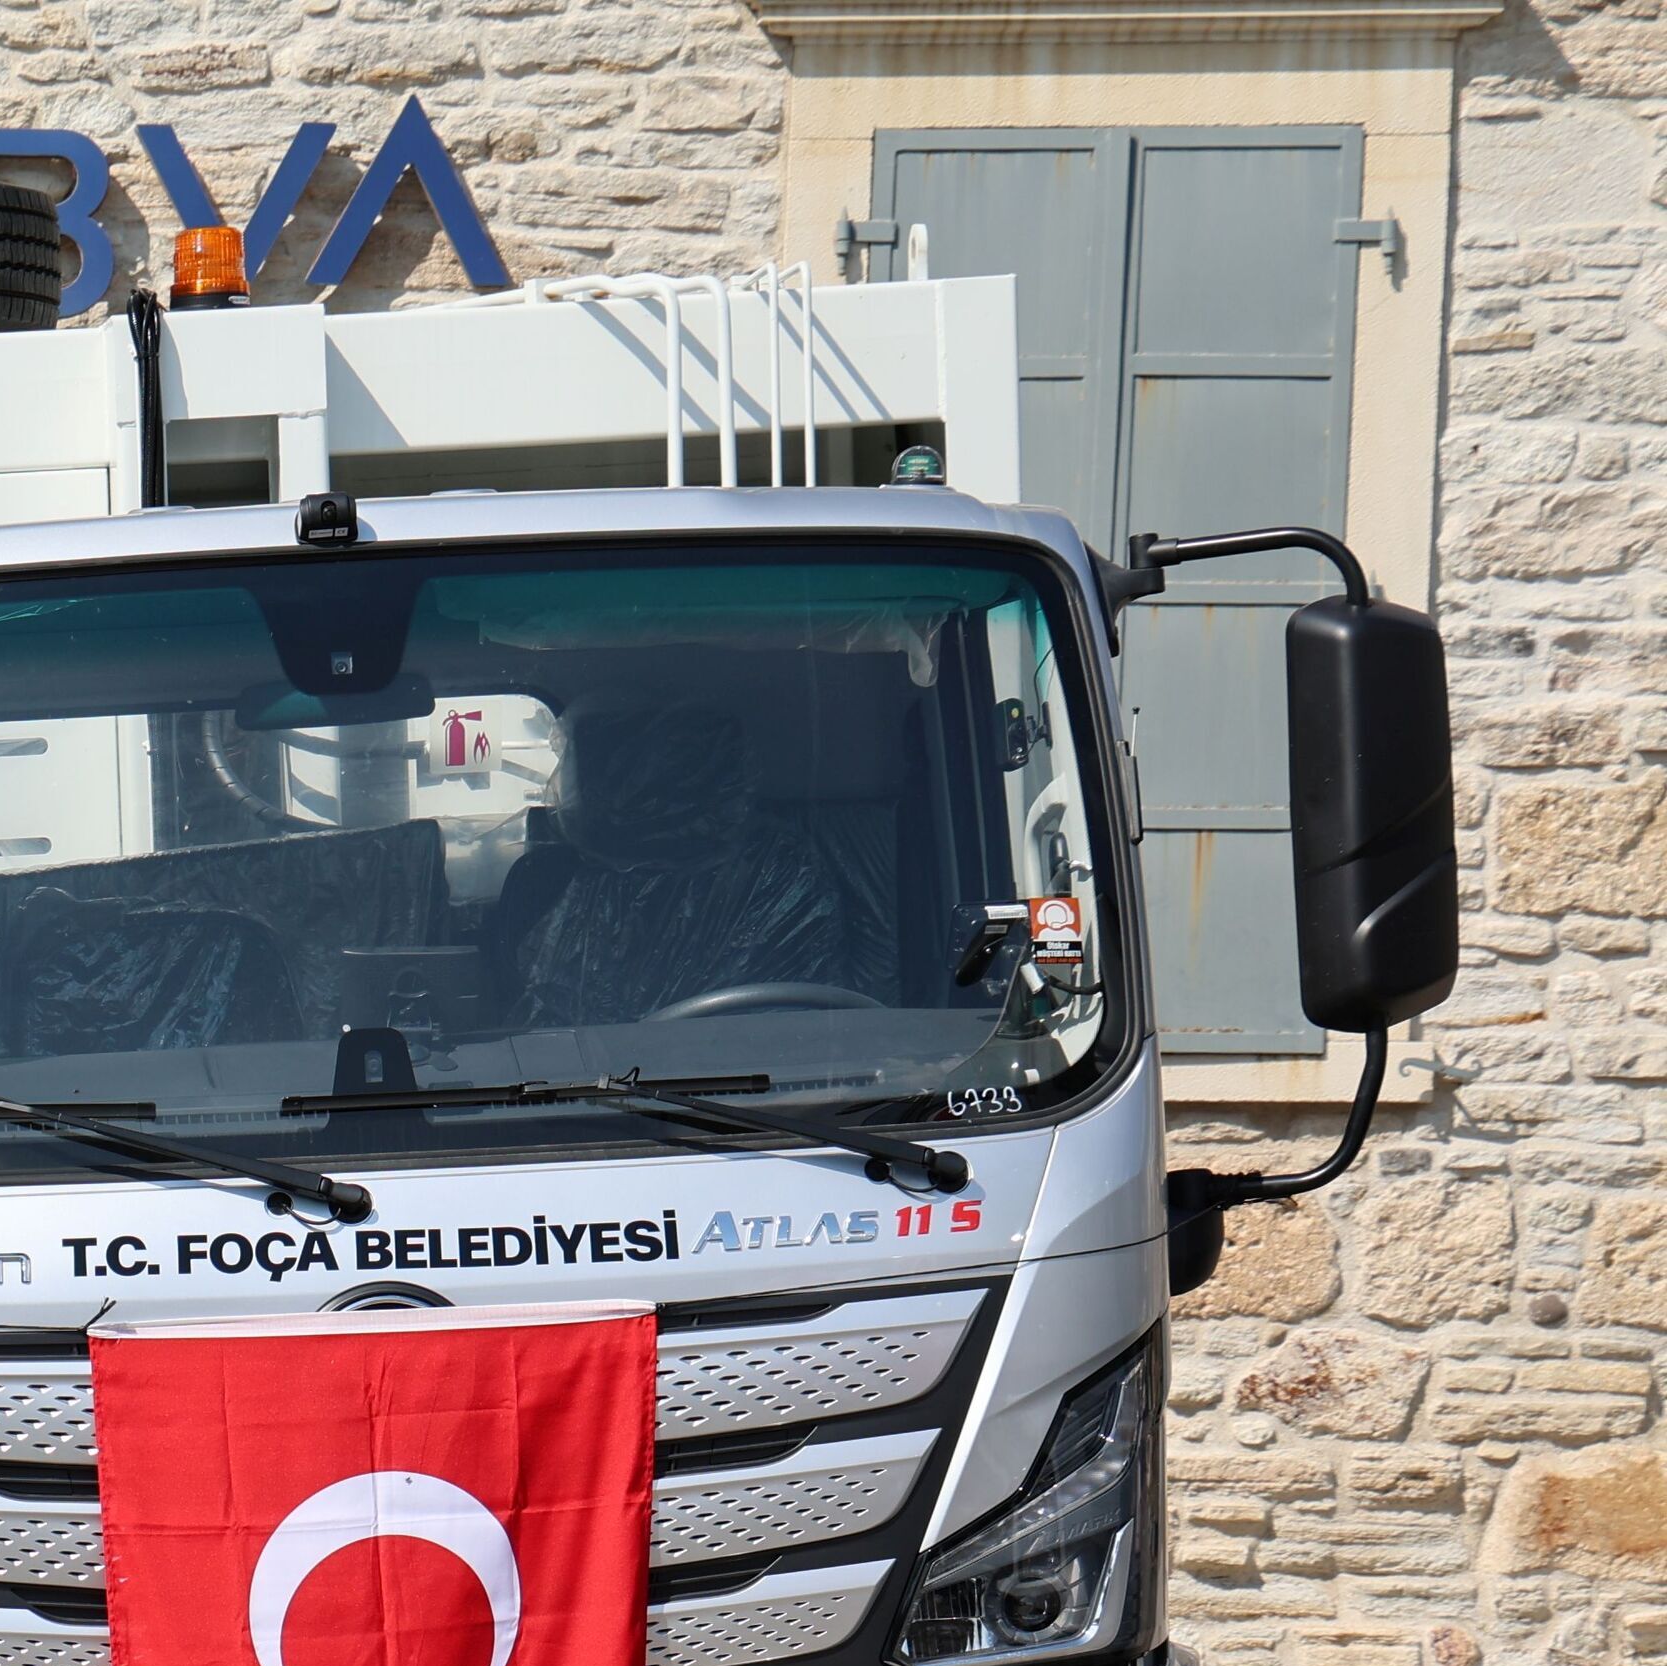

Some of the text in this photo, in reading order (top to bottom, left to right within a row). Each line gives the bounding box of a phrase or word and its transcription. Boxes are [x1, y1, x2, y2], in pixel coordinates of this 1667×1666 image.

[62, 1208, 680, 1284] T.C. FOÇA BELEDİYESİ
[691, 1210, 880, 1254] ATLAS
